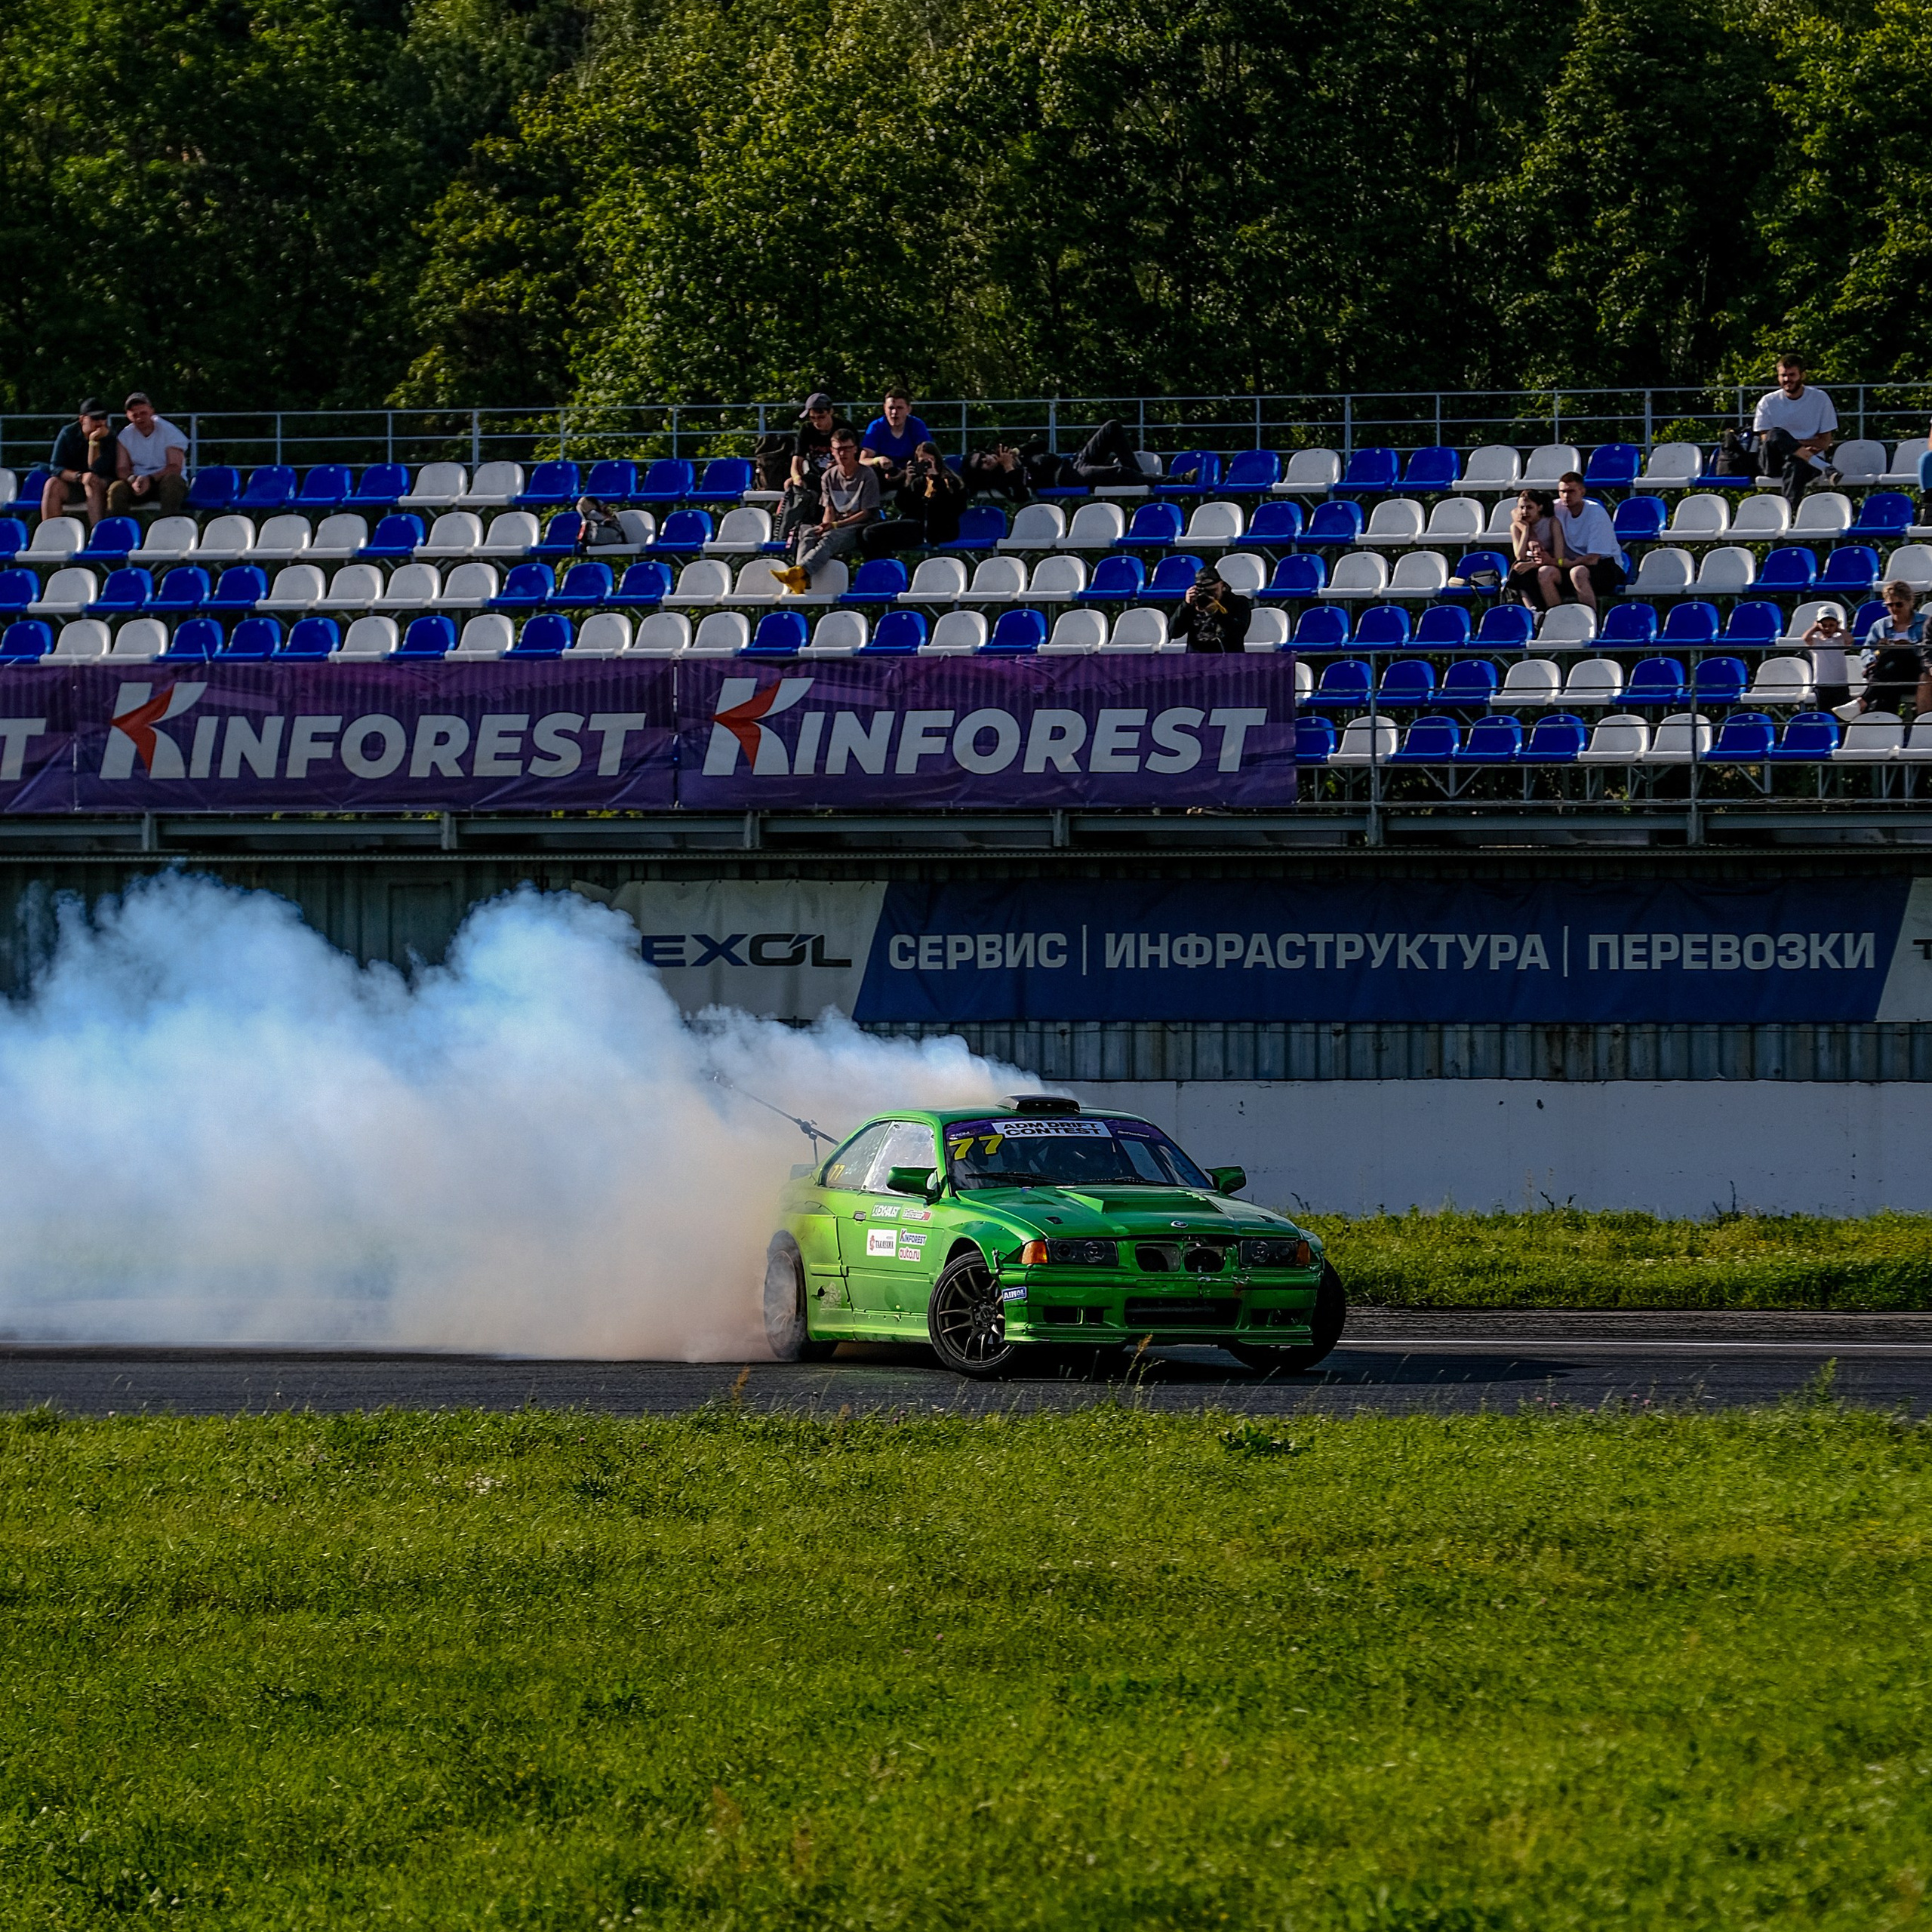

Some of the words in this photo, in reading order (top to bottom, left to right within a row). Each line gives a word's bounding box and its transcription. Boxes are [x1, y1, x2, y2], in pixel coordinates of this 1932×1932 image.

[100, 681, 647, 780] KINFOREST
[702, 678, 1267, 776] KINFOREST
[888, 932, 1068, 970] СЕРВИС
[1105, 932, 1550, 970] ИНФРАСТРУКТУРА
[1589, 932, 1875, 970] ПЕРЕВОЗКИ
[949, 1134, 1004, 1161] 77
[900, 1229, 927, 1244] KINFOREST
[899, 1248, 920, 1260] auto.ru
